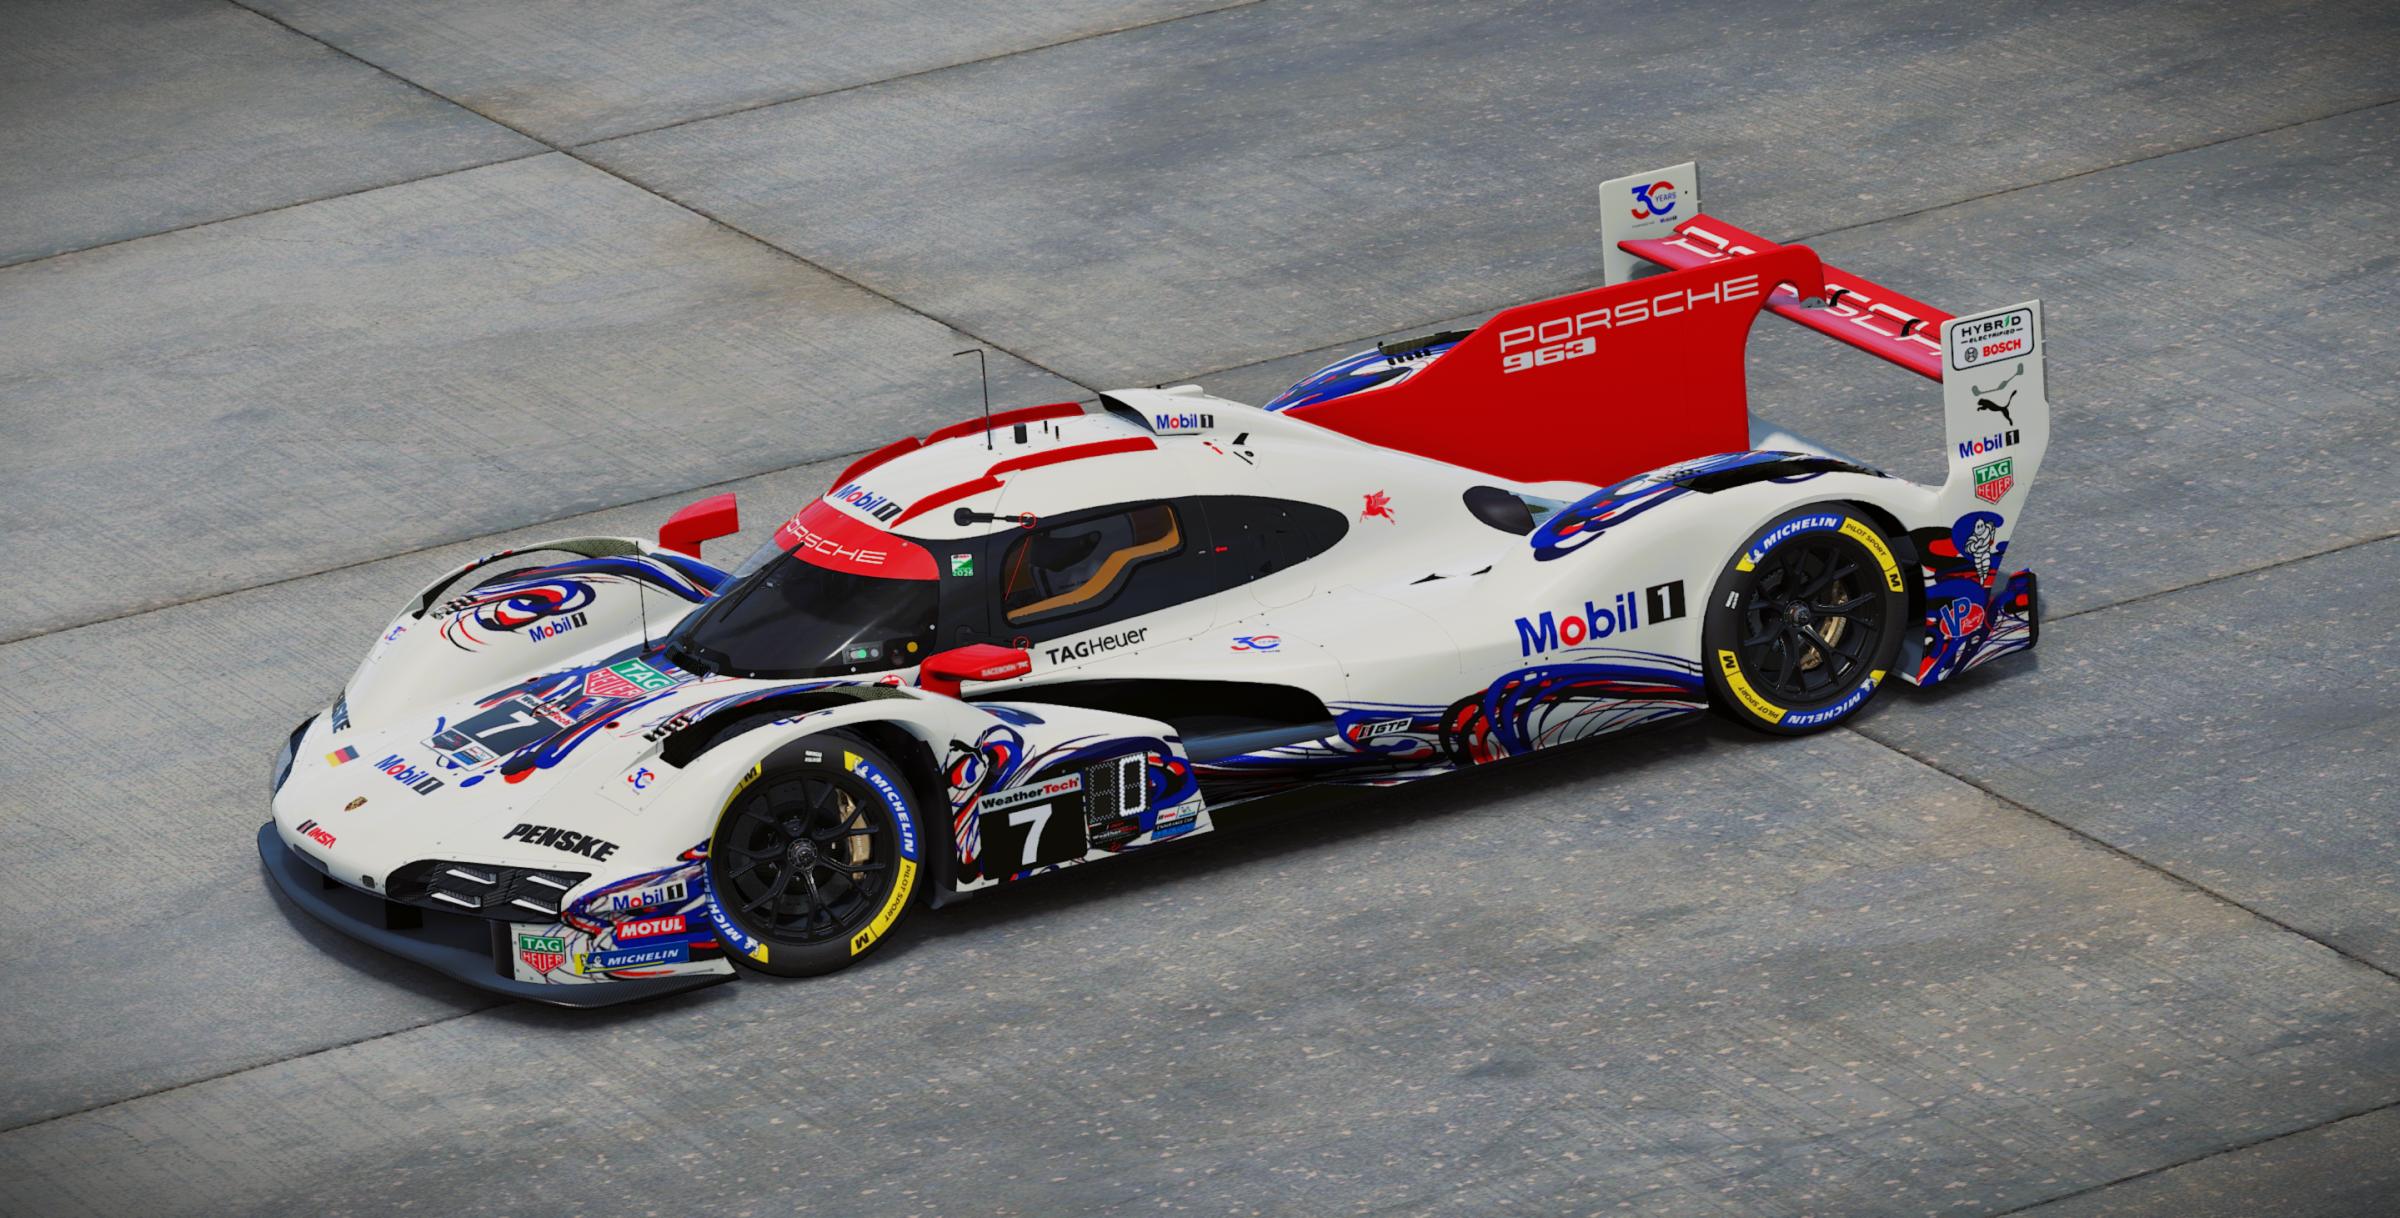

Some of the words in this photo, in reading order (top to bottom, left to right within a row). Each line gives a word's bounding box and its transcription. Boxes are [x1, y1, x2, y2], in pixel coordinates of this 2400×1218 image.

[1656, 191, 1677, 202] YEARS
[1500, 274, 1760, 353] PORSCHE
[1969, 328, 2016, 344] ELECTRIFIED
[1982, 339, 2022, 358] BOSCH
[1503, 336, 1597, 374] 963
[1156, 413, 1198, 430] Mobil
[1200, 414, 1214, 429] 1
[1958, 433, 2003, 459] Mobil
[2005, 429, 2020, 446] 1
[1976, 461, 2011, 483] TAG
[1977, 476, 2013, 501] HEUER
[833, 484, 887, 513] Mobil
[873, 502, 903, 522] 1
[787, 513, 888, 565] ORSCHE
[1762, 517, 1838, 549] MICHELIN
[1846, 523, 1867, 537] PILOT
[1866, 534, 1887, 556] SPORT
[1889, 573, 1901, 588] M
[528, 616, 572, 643] Mobil
[572, 611, 588, 628] 1
[1515, 591, 1639, 657] Mobil
[1647, 580, 1686, 625] 1
[1940, 597, 1972, 637] VP
[1046, 627, 1148, 666] TAGHeuer
[620, 662, 671, 689] TAG
[1722, 655, 1736, 669] M
[590, 670, 642, 697] HEUER
[1738, 686, 1760, 707] SPORT
[1757, 705, 1780, 719] PILOT
[1787, 694, 1861, 725] MICHELIN
[475, 710, 540, 740] 7
[1375, 720, 1410, 734] GTP
[373, 753, 430, 786] Mobil
[413, 777, 445, 796] 1
[981, 778, 1079, 810] WeatherTech
[870, 773, 914, 853] MICHELIN
[308, 827, 337, 849] IMSA
[502, 823, 620, 863] PENSKE
[1008, 803, 1053, 866] 7
[901, 864, 912, 891] PILOT
[613, 887, 664, 911] Mobil
[666, 884, 685, 901] 1
[885, 892, 904, 922] SPORT
[620, 918, 683, 938] MOTUL
[855, 932, 870, 950] M
[522, 937, 561, 952] TAG
[607, 949, 679, 967] MICHELIN
[522, 952, 564, 973] HEUER
